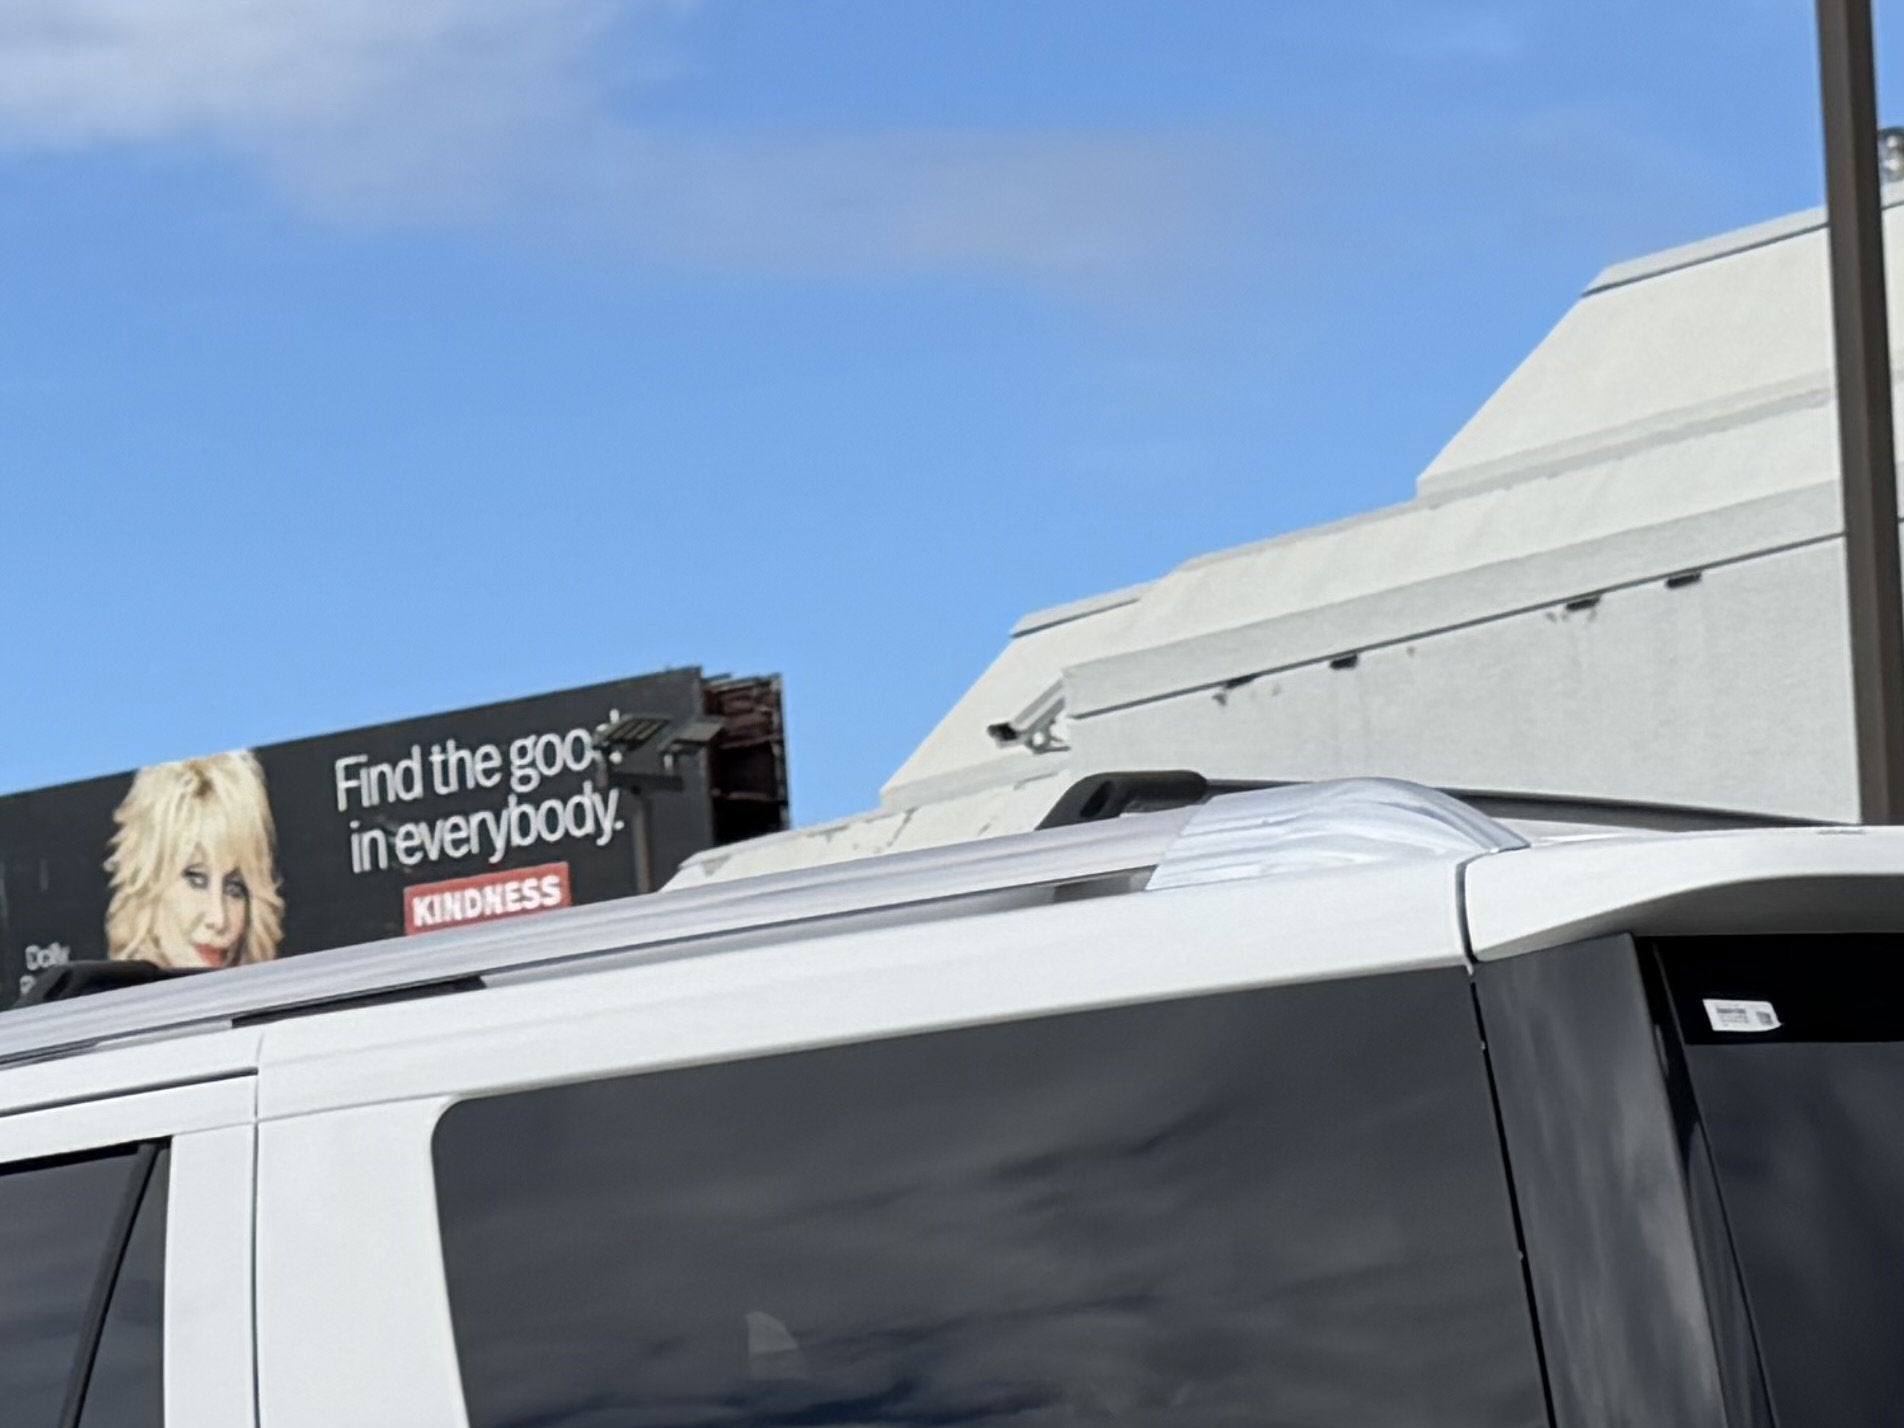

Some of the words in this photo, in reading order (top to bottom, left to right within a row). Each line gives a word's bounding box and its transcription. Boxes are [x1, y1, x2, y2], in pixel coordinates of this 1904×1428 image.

[334, 744, 424, 813] Find
[429, 738, 502, 795] the
[349, 820, 389, 874] in
[395, 779, 625, 864] everybody.
[411, 873, 563, 927] KINDNESS
